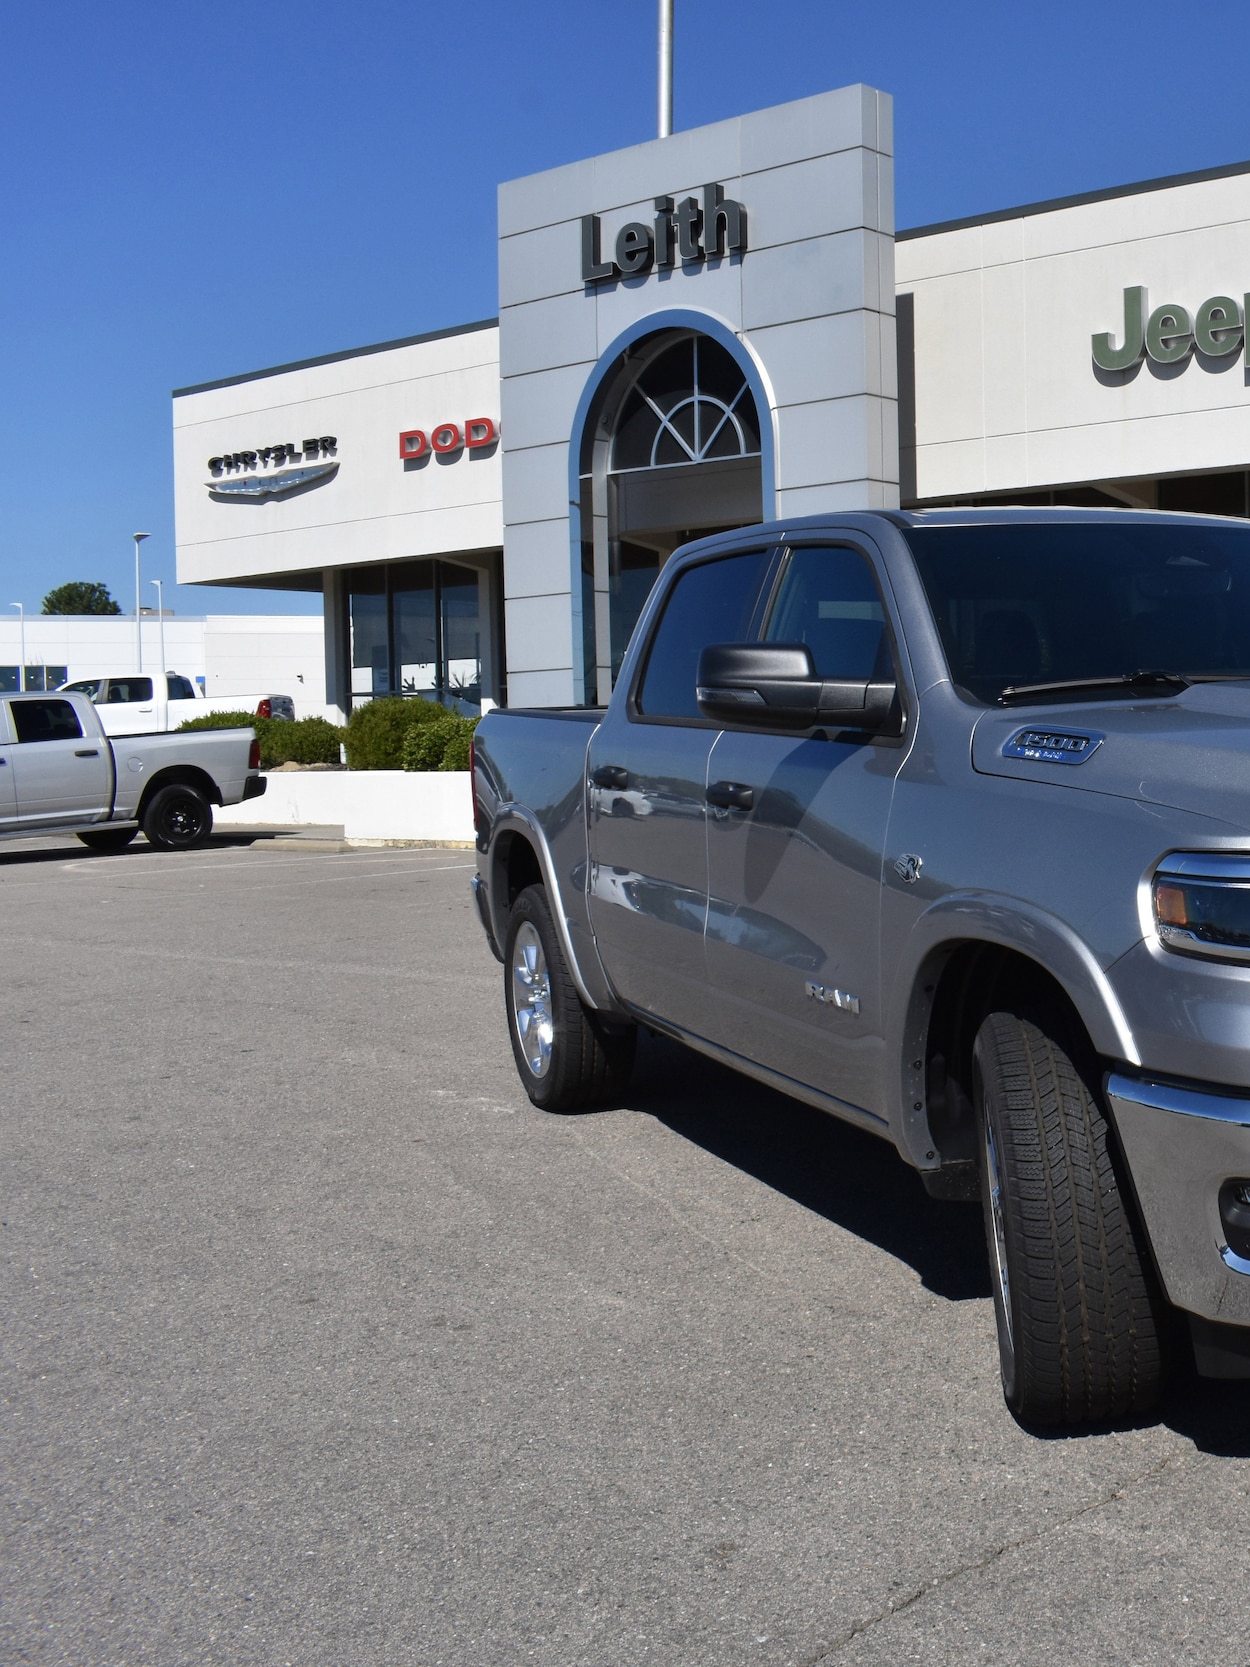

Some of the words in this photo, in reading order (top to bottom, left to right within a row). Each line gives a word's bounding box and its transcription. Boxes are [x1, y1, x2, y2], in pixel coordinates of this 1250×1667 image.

[581, 183, 748, 281] Leith
[207, 435, 338, 471] CHRYSLER
[399, 417, 501, 459] DOD
[1018, 732, 1088, 752] 1500
[804, 979, 860, 1014] RAM
